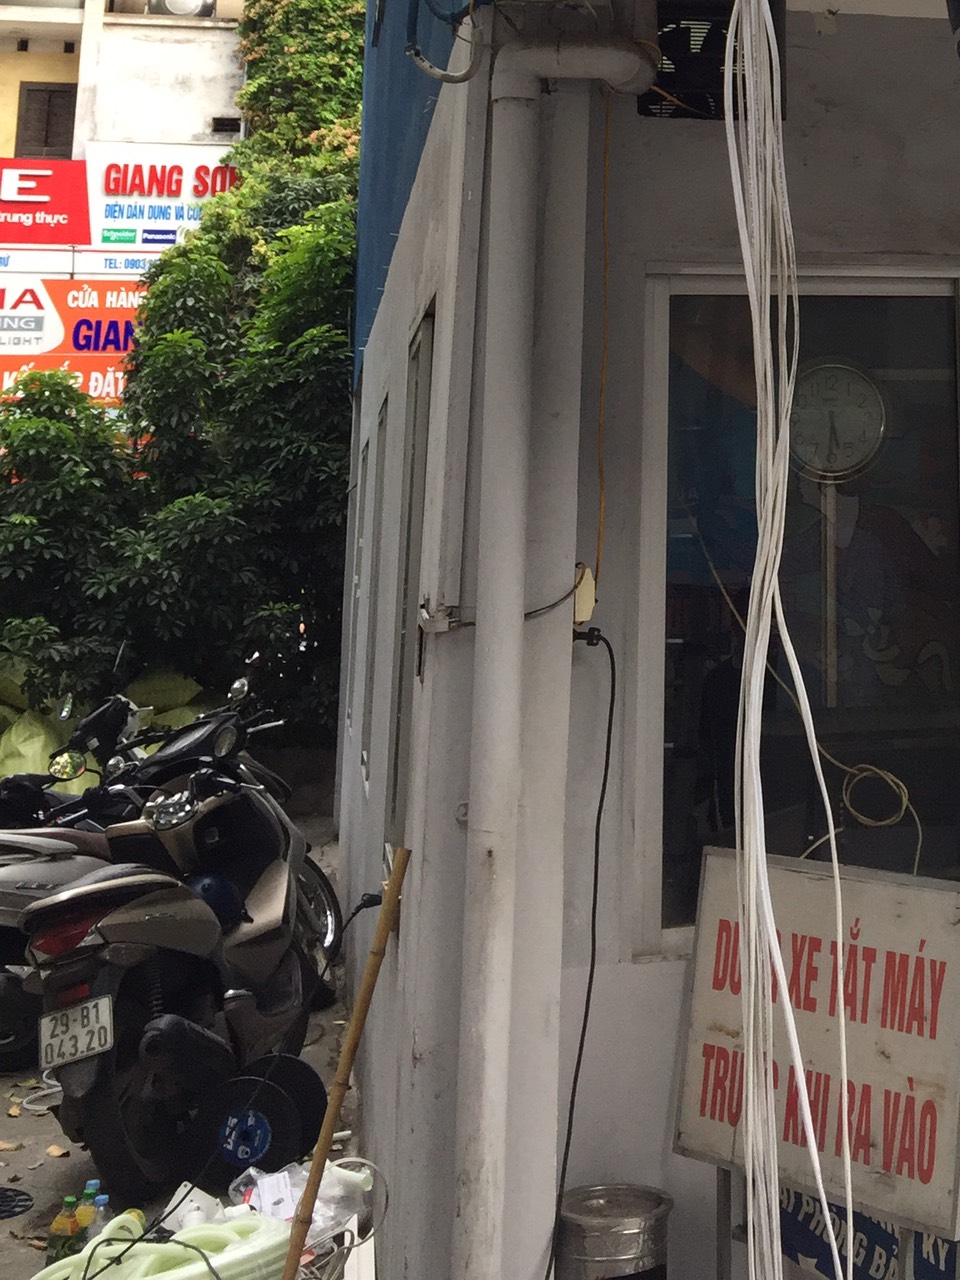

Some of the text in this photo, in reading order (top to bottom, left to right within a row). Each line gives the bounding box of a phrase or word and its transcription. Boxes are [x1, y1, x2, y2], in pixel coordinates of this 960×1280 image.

[104, 163, 183, 197] GIANG
[35, 211, 68, 228] thực
[104, 202, 124, 222] ĐIỆN
[148, 205, 171, 223] DỤNG
[175, 203, 184, 220] VÀ
[142, 232, 176, 240] Panasonic
[67, 284, 98, 308] CỬA
[787, 932, 821, 1013] XE
[829, 917, 877, 1024] TẮT
[880, 939, 947, 1041] MÁY
[49, 1002, 100, 1039] 29-B1
[45, 1025, 108, 1064] 043.20
[783, 1064, 831, 1153] KHI
[835, 1080, 872, 1167] RA
[881, 1076, 937, 1185] VÀO
